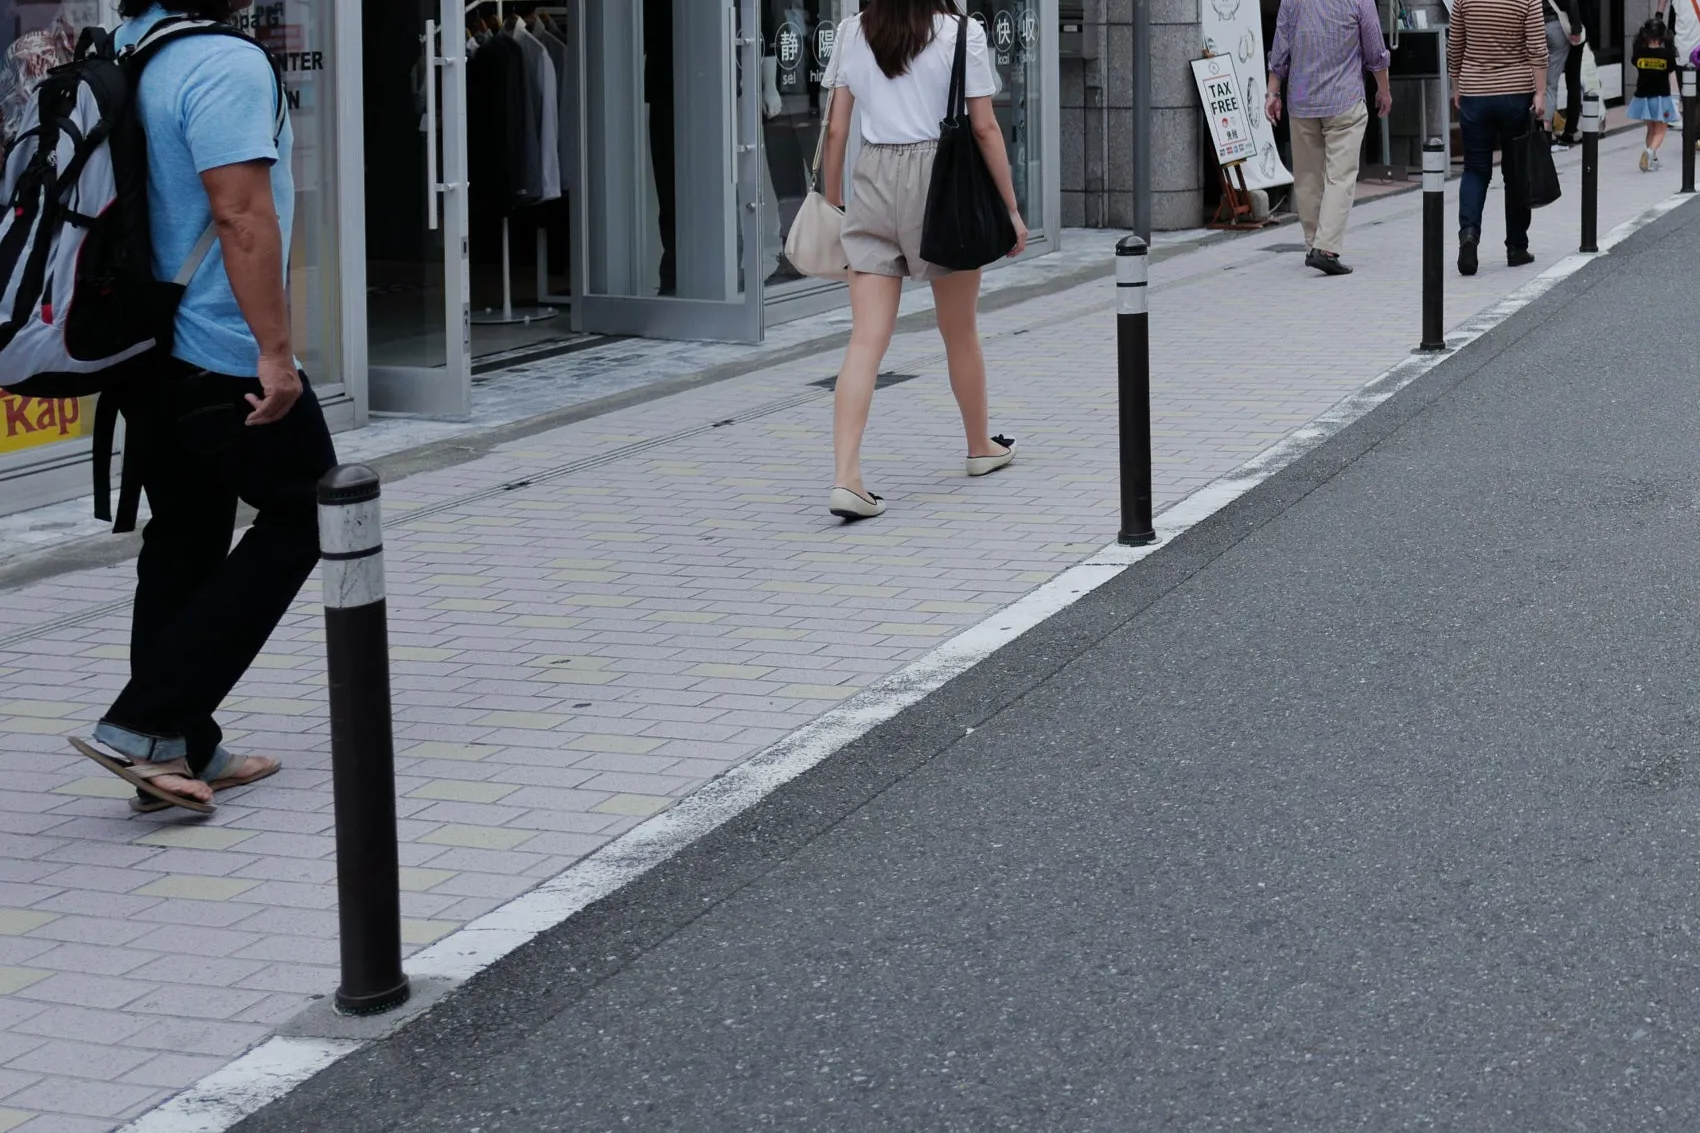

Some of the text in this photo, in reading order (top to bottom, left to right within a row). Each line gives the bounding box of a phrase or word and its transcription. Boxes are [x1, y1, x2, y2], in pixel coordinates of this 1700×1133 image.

[996, 17, 1011, 45] 快
[781, 29, 799, 61] 静
[1208, 81, 1232, 98] TAX
[1210, 97, 1238, 115] FREE
